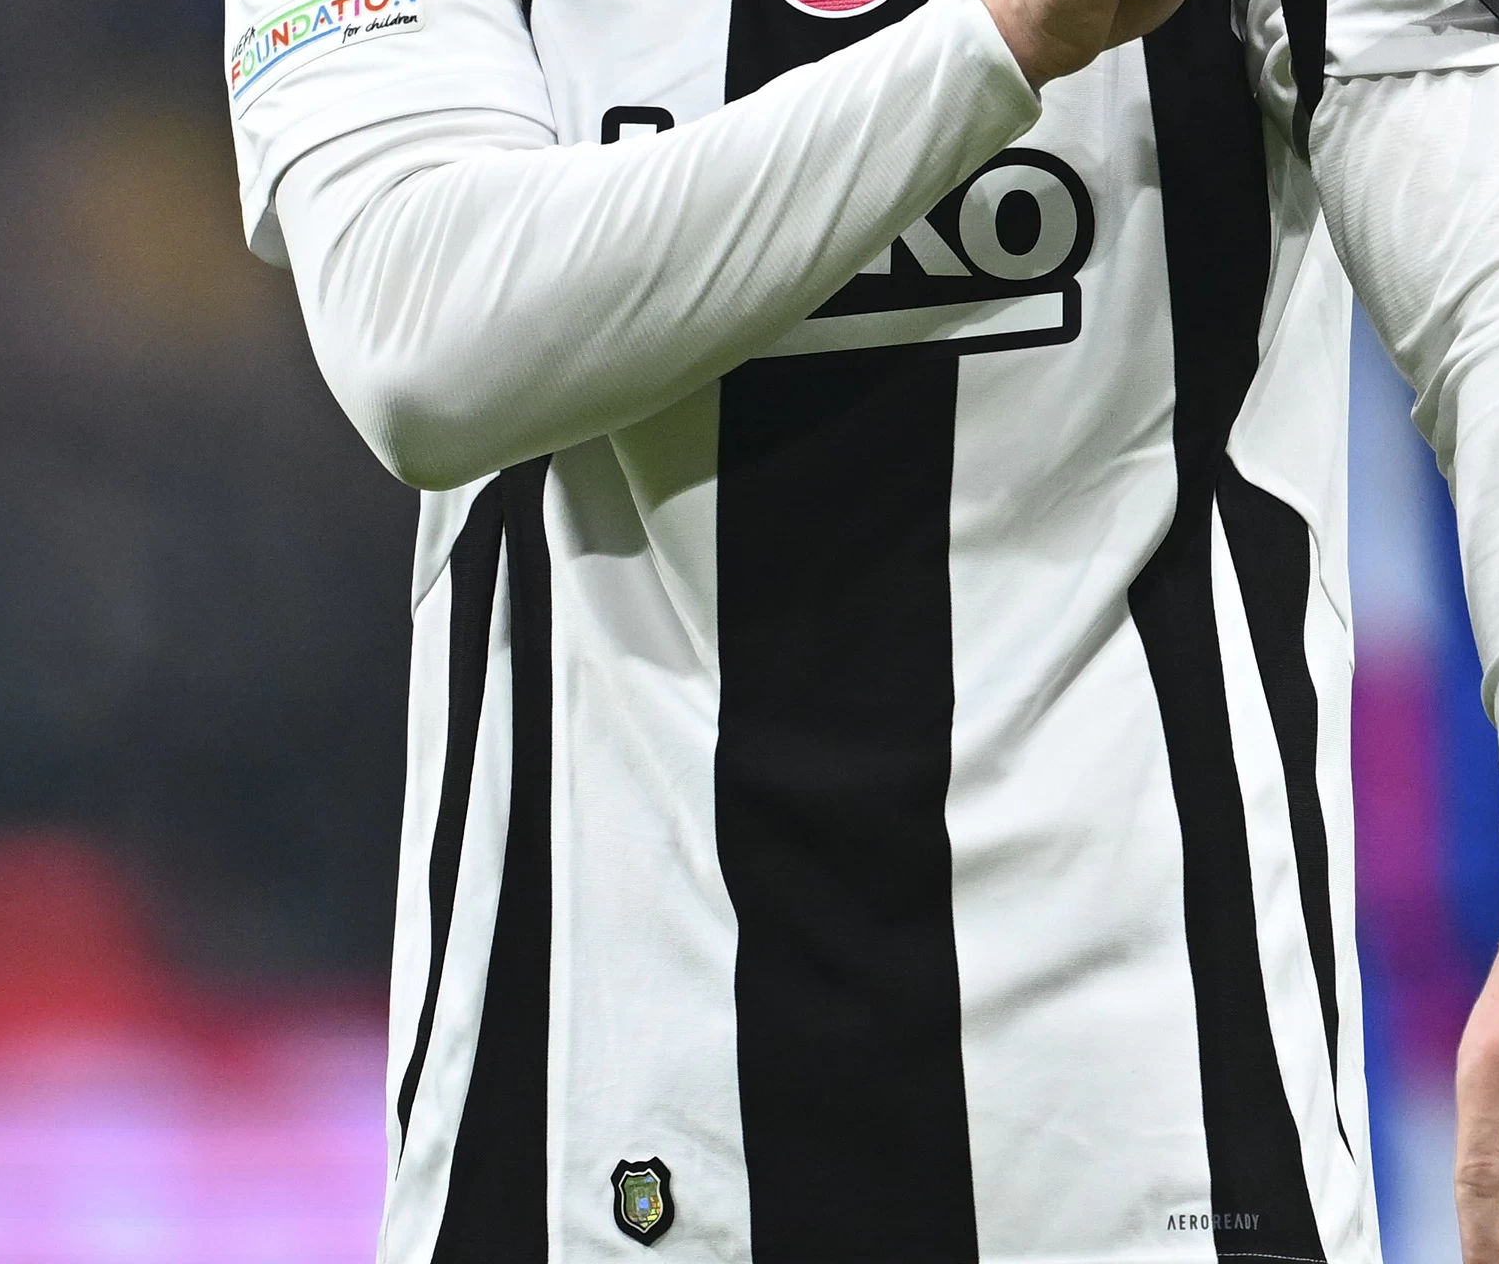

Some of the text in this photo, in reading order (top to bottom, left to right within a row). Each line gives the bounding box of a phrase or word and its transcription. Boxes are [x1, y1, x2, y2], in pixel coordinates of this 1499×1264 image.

[231, 25, 256, 63] UEFA
[342, 13, 419, 44] for children
[1167, 1212, 1260, 1231] AEROREADY
